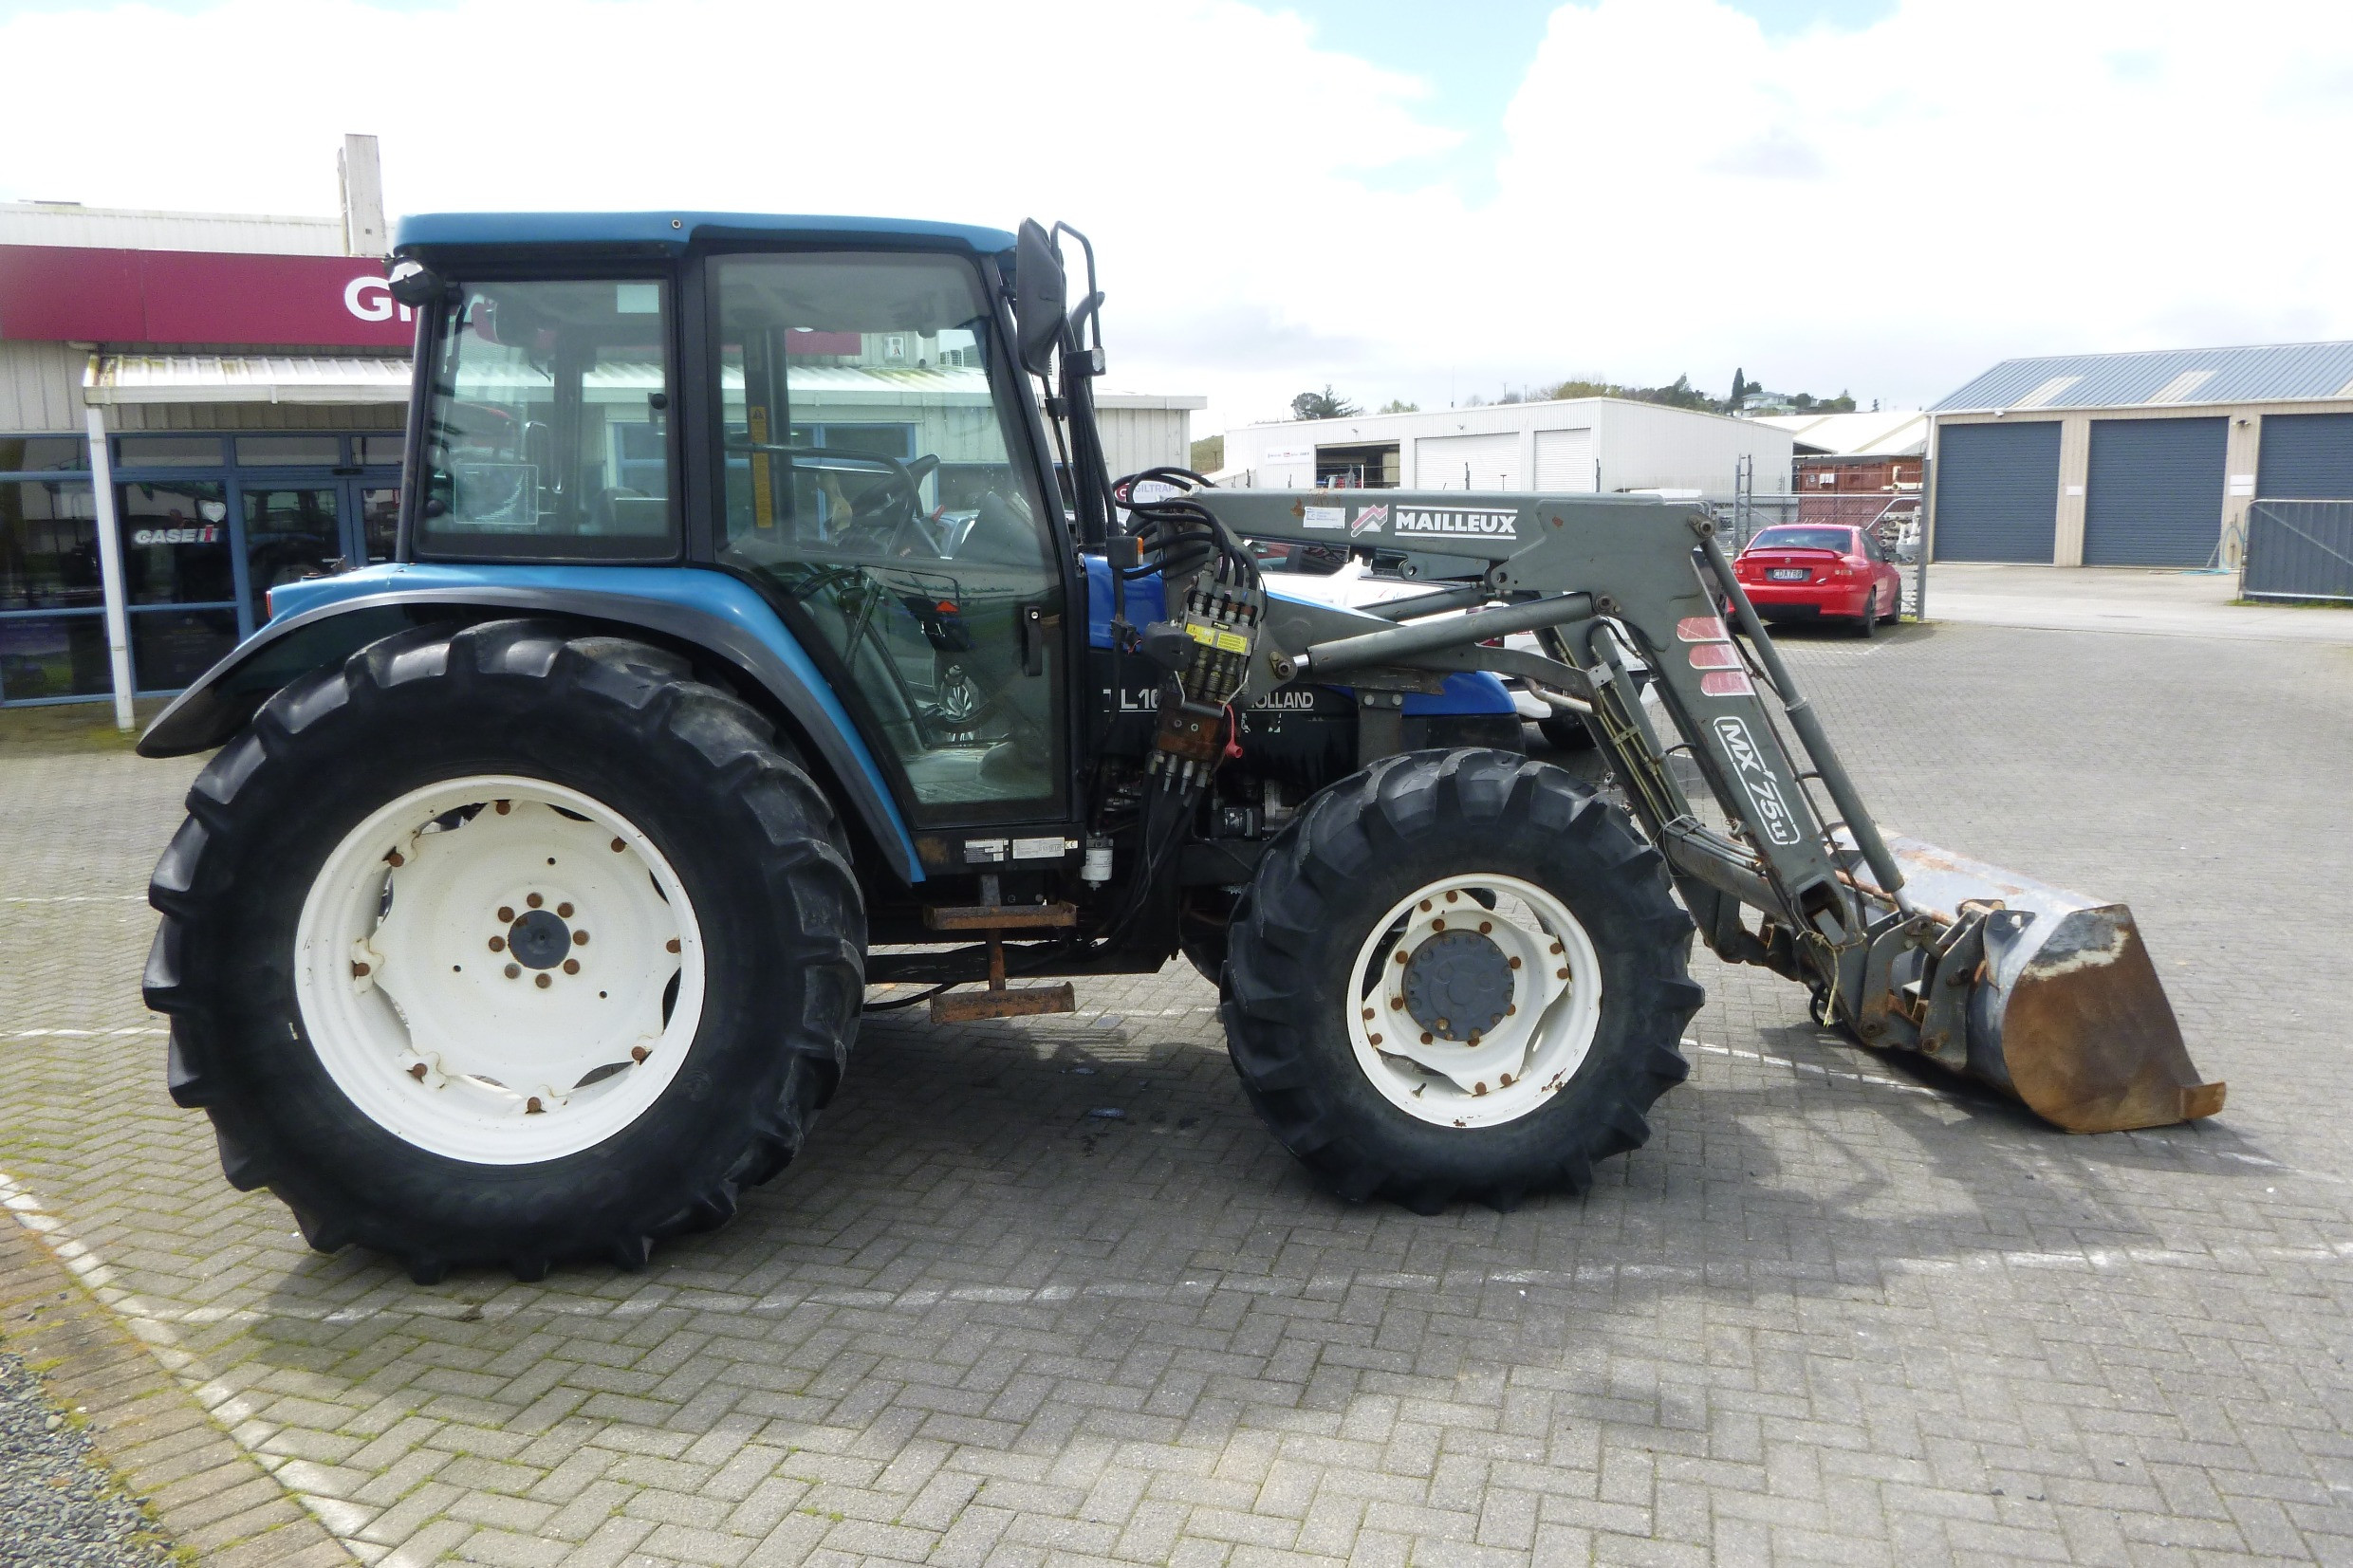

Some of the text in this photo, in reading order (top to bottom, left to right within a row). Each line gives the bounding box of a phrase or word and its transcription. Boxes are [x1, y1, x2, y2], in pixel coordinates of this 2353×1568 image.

[1396, 511, 1517, 534] MAILLEUX
[135, 528, 197, 544] CASE
[1251, 692, 1314, 709] OLLAND
[1720, 725, 1762, 772] MX
